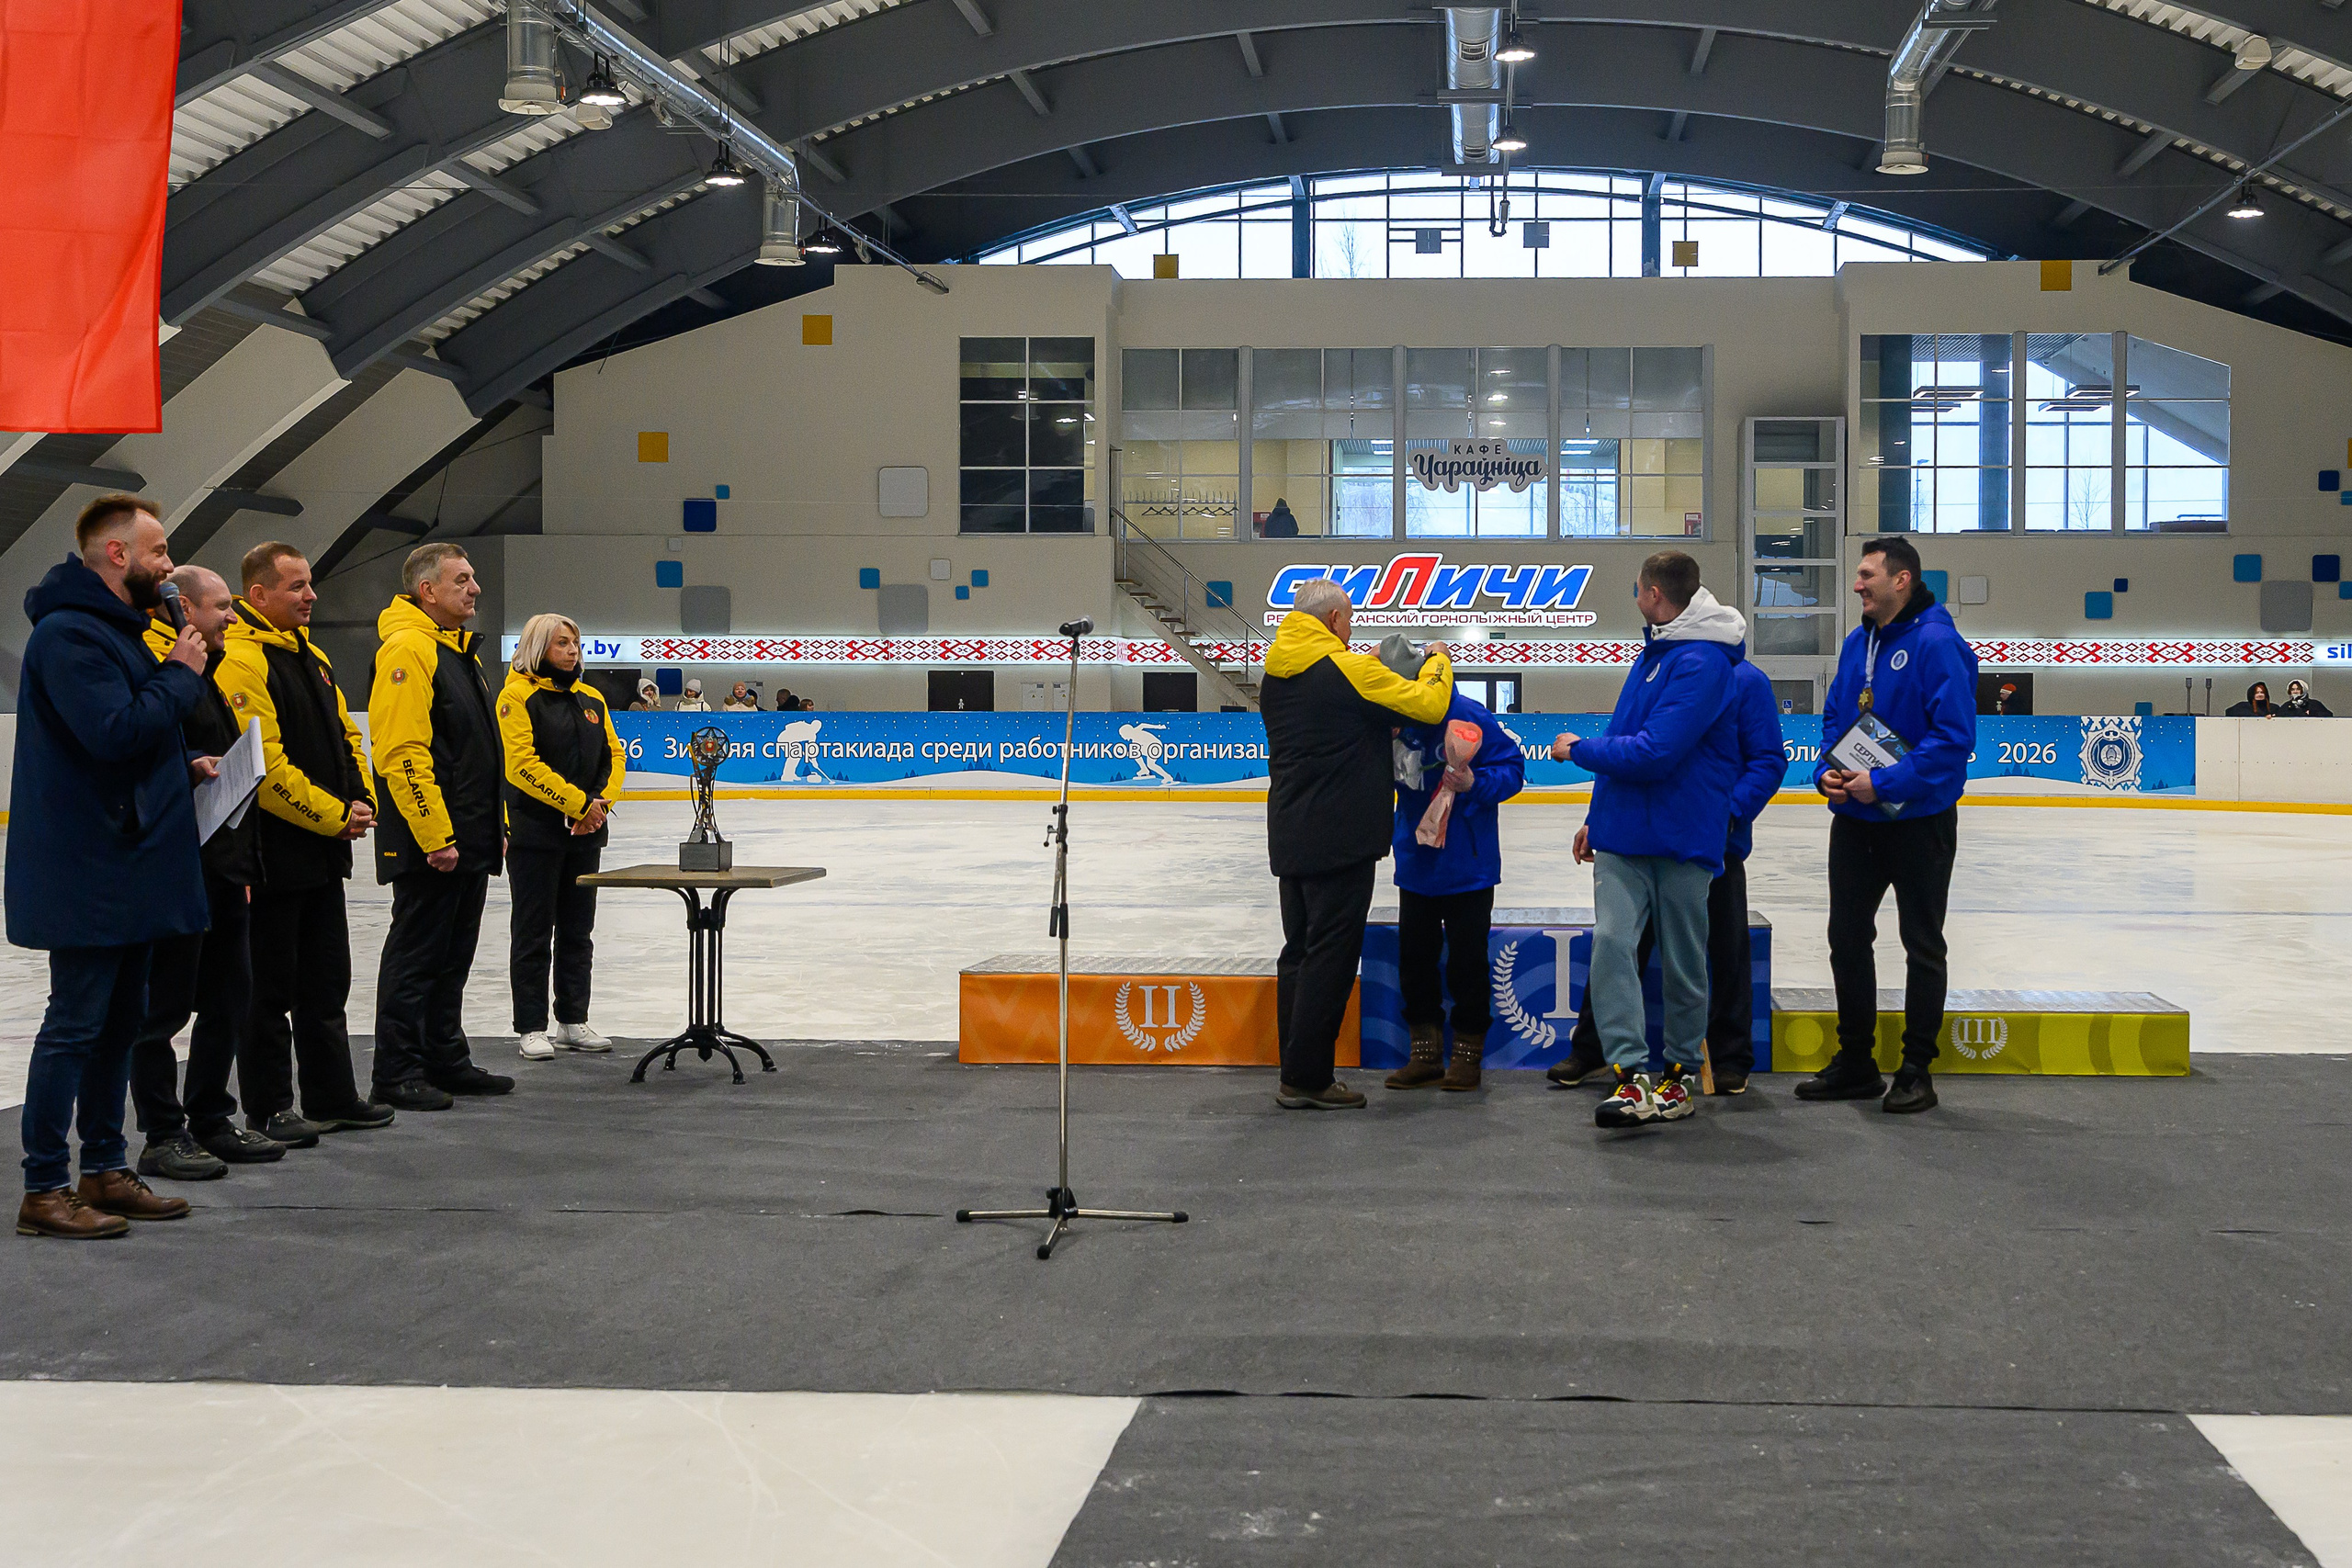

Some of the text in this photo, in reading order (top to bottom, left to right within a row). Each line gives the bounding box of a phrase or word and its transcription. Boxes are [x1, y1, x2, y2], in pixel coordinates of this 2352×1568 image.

[1453, 445, 1501, 455] КАФЕ
[1267, 612, 1594, 626] РЕАНСКИЙ ГОРНОЛЫЖНЫЙ ЦЕНТР
[663, 737, 755, 760] Зияя
[762, 741, 915, 763] спартакиада
[921, 741, 993, 763] среди
[999, 736, 1142, 763] работников
[1148, 741, 1270, 764] организац
[1997, 742, 2057, 764] 2026
[272, 782, 322, 823] BELARUS
[402, 759, 430, 818] BELARUS
[519, 768, 567, 806] BELARUS
[1138, 985, 1182, 1028] II
[1962, 1018, 1998, 1043] III
